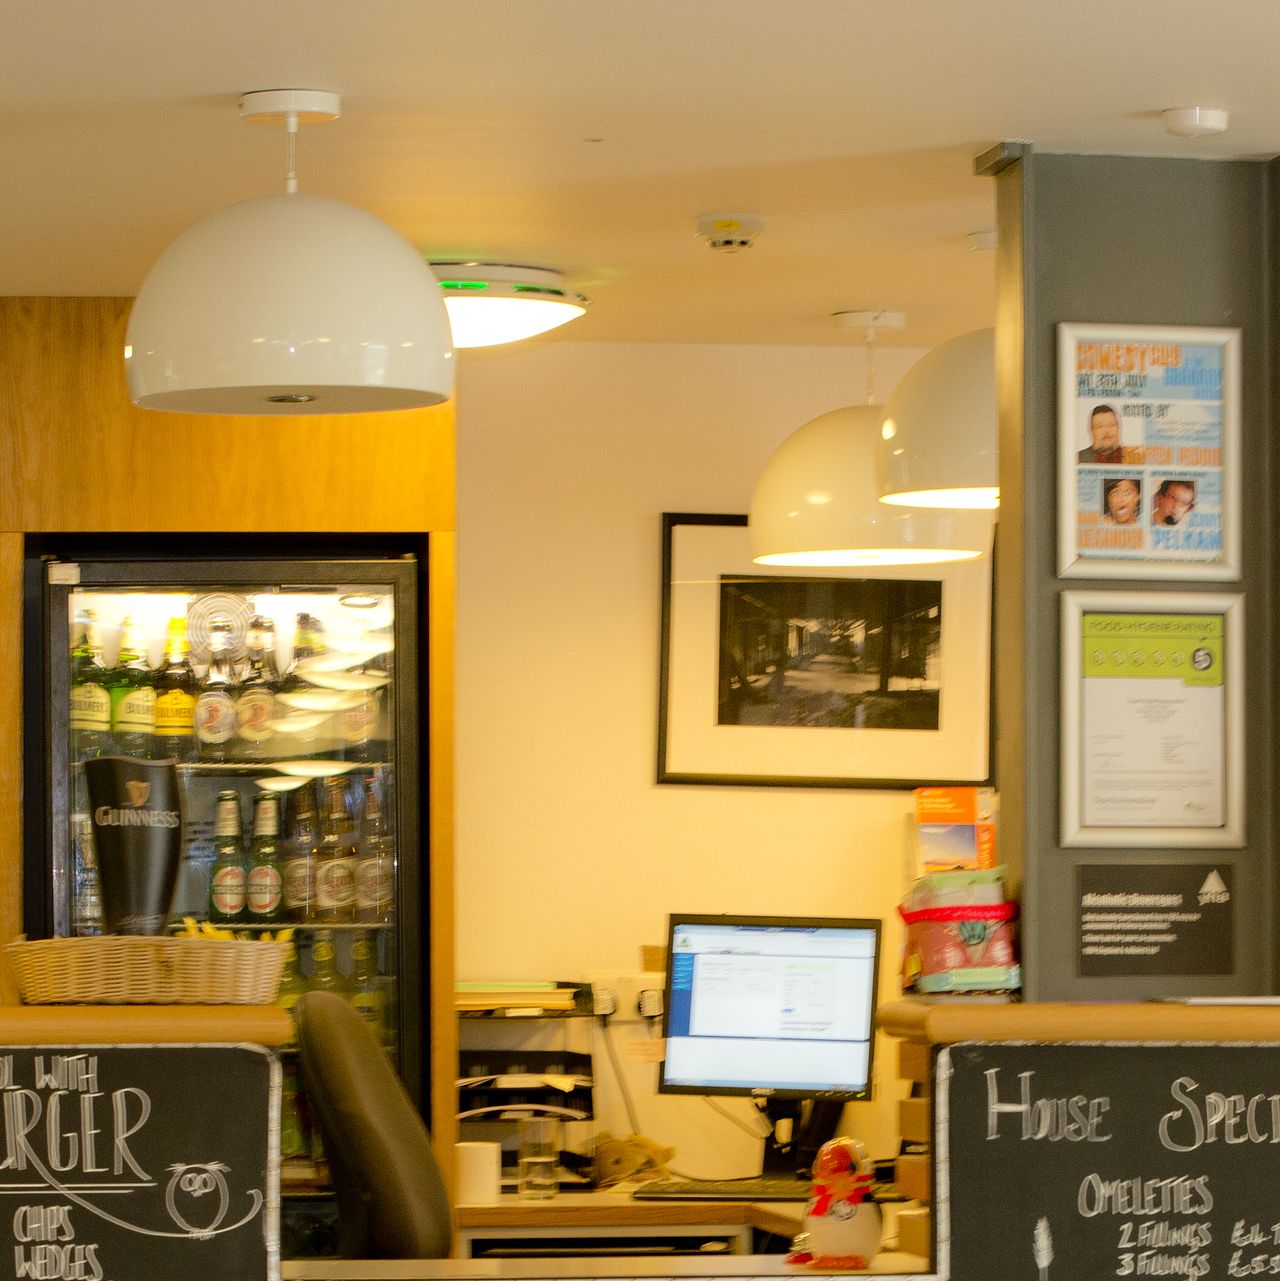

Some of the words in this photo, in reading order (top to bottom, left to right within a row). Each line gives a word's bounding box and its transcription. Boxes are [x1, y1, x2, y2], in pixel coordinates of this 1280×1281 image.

[94, 806, 180, 828] GUINNESS
[35, 1054, 97, 1093] WITH
[983, 1067, 1112, 1142] HOUSE
[1077, 1172, 1214, 1219] OMELETTES
[13, 1204, 75, 1242] CHIPS
[1117, 1222, 1135, 1249] 2
[15, 1243, 103, 1281] WEDGES
[1116, 1254, 1134, 1276] 3
